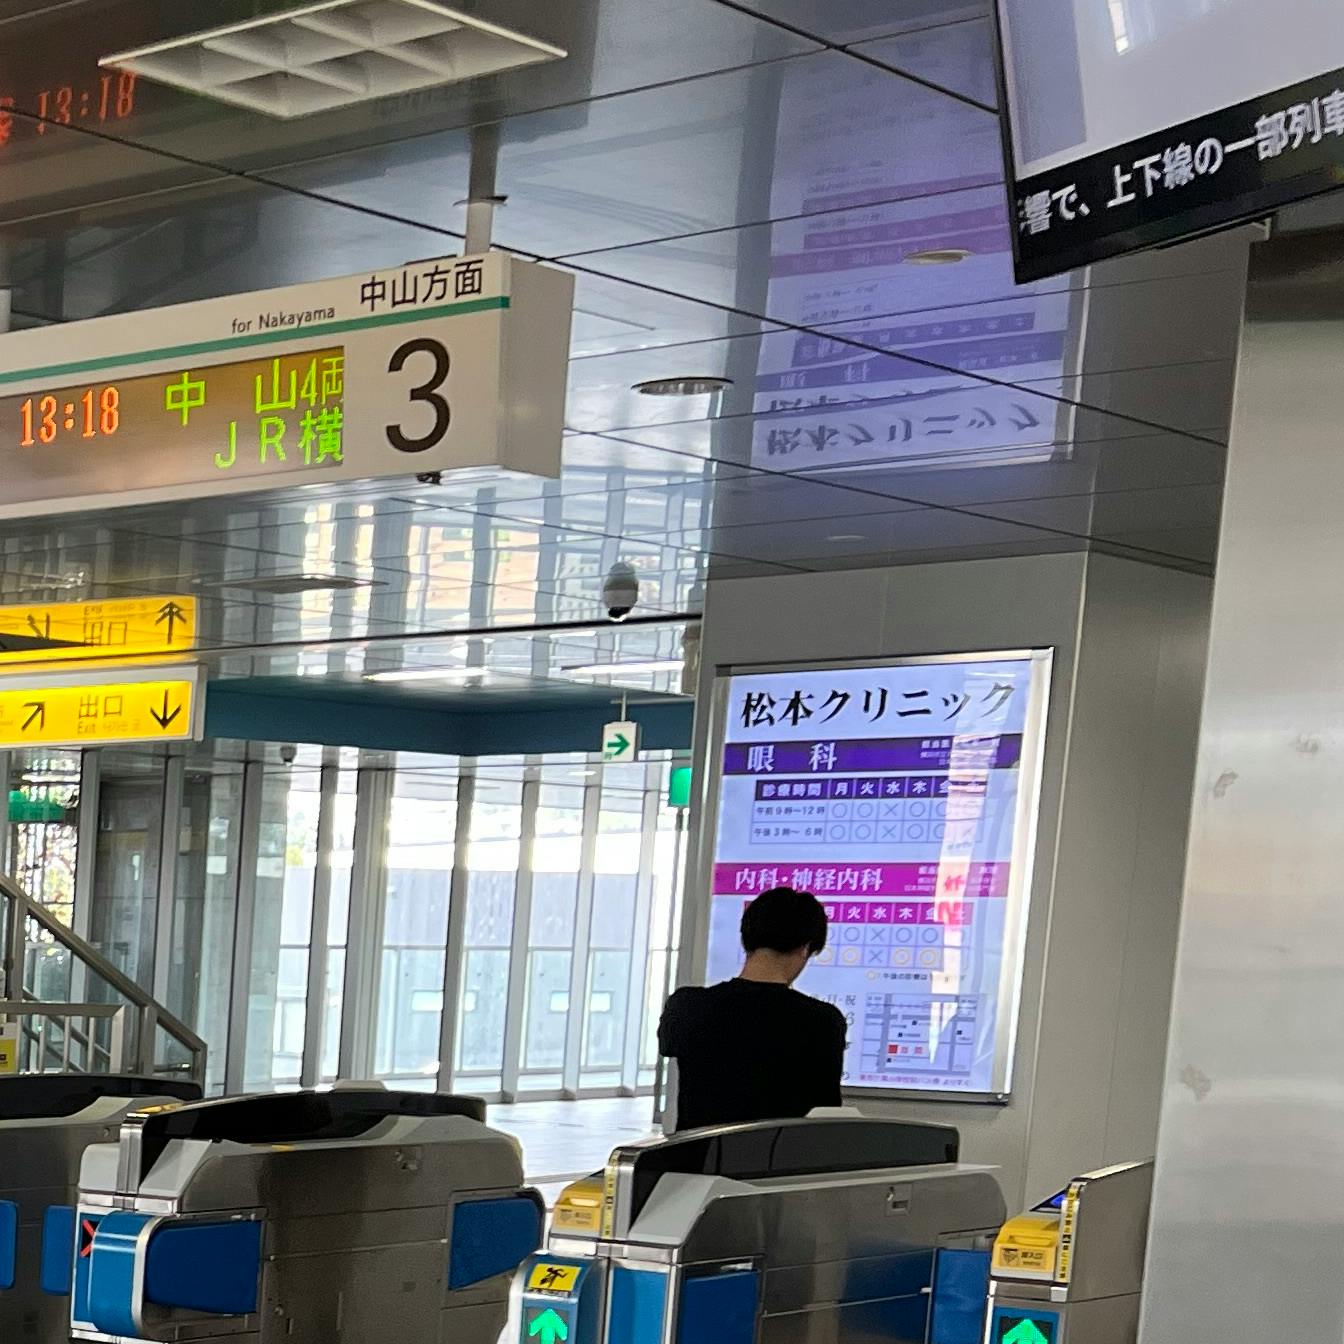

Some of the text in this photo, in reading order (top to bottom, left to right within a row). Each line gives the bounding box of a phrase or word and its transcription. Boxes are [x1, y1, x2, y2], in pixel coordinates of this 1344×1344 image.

[358, 259, 485, 313] 中山方面
[231, 305, 336, 335] for Nakayama
[385, 337, 451, 454] 3
[20, 385, 120, 447] 13:18
[79, 695, 123, 719] 出口
[741, 682, 1016, 728] 松本クリニック
[747, 742, 838, 772] 眼科
[835, 782, 849, 796] 月
[860, 782, 875, 795] 火
[886, 781, 901, 795] 水
[912, 780, 928, 794] 木
[735, 868, 883, 891] 内科・神経内科
[848, 906, 861, 919] 火
[872, 906, 887, 919] 水
[899, 907, 913, 920] 木
